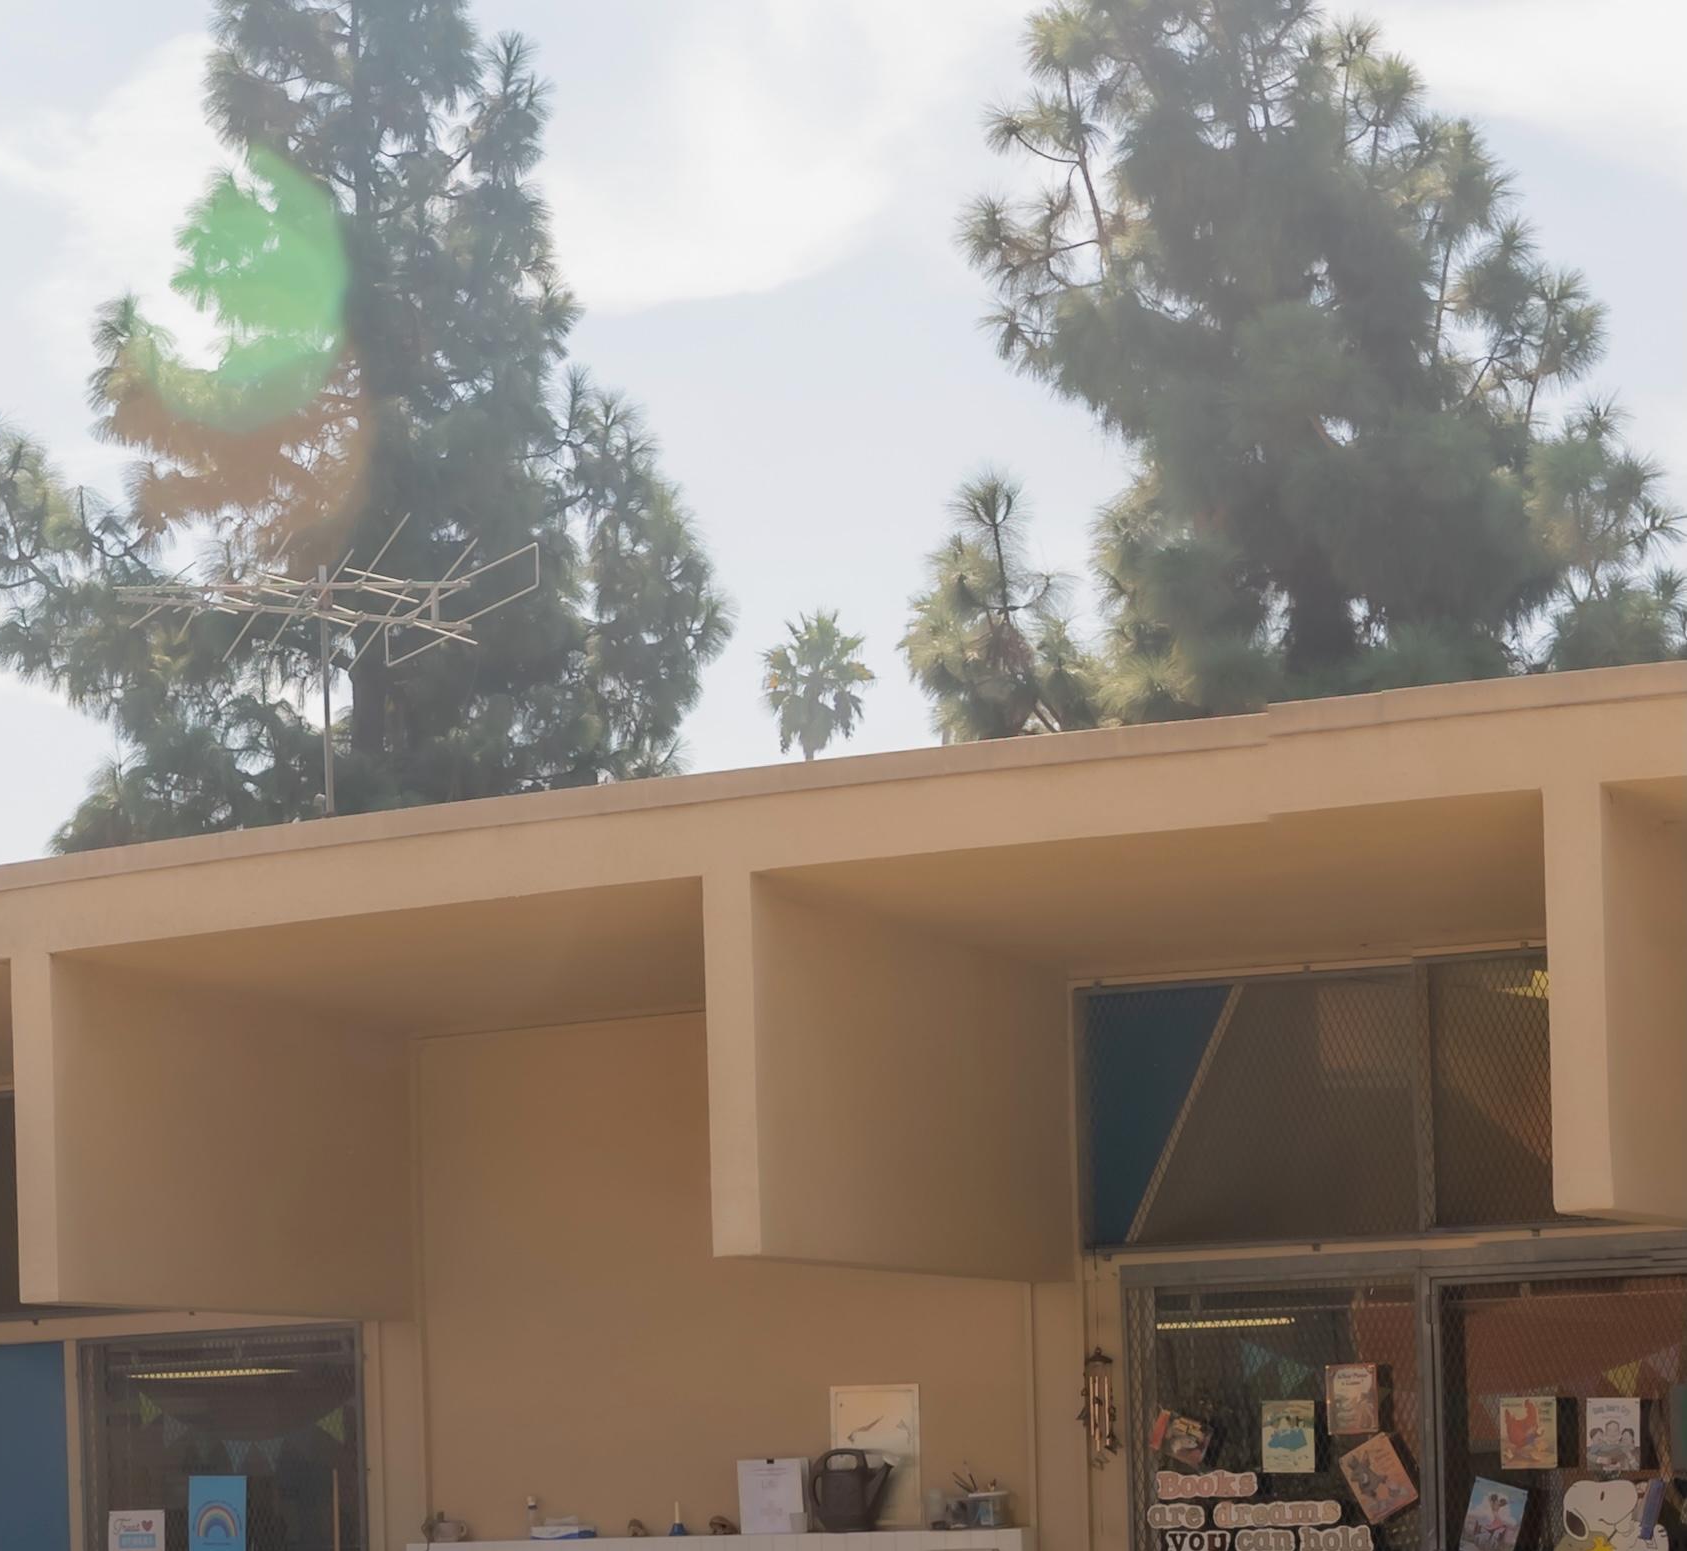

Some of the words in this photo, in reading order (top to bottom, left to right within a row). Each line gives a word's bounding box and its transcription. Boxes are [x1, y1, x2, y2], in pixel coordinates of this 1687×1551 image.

[1157, 1471, 1256, 1498] Books
[113, 1518, 141, 1536] Treat
[1148, 1504, 1203, 1528] are
[1214, 1501, 1340, 1527] dreams
